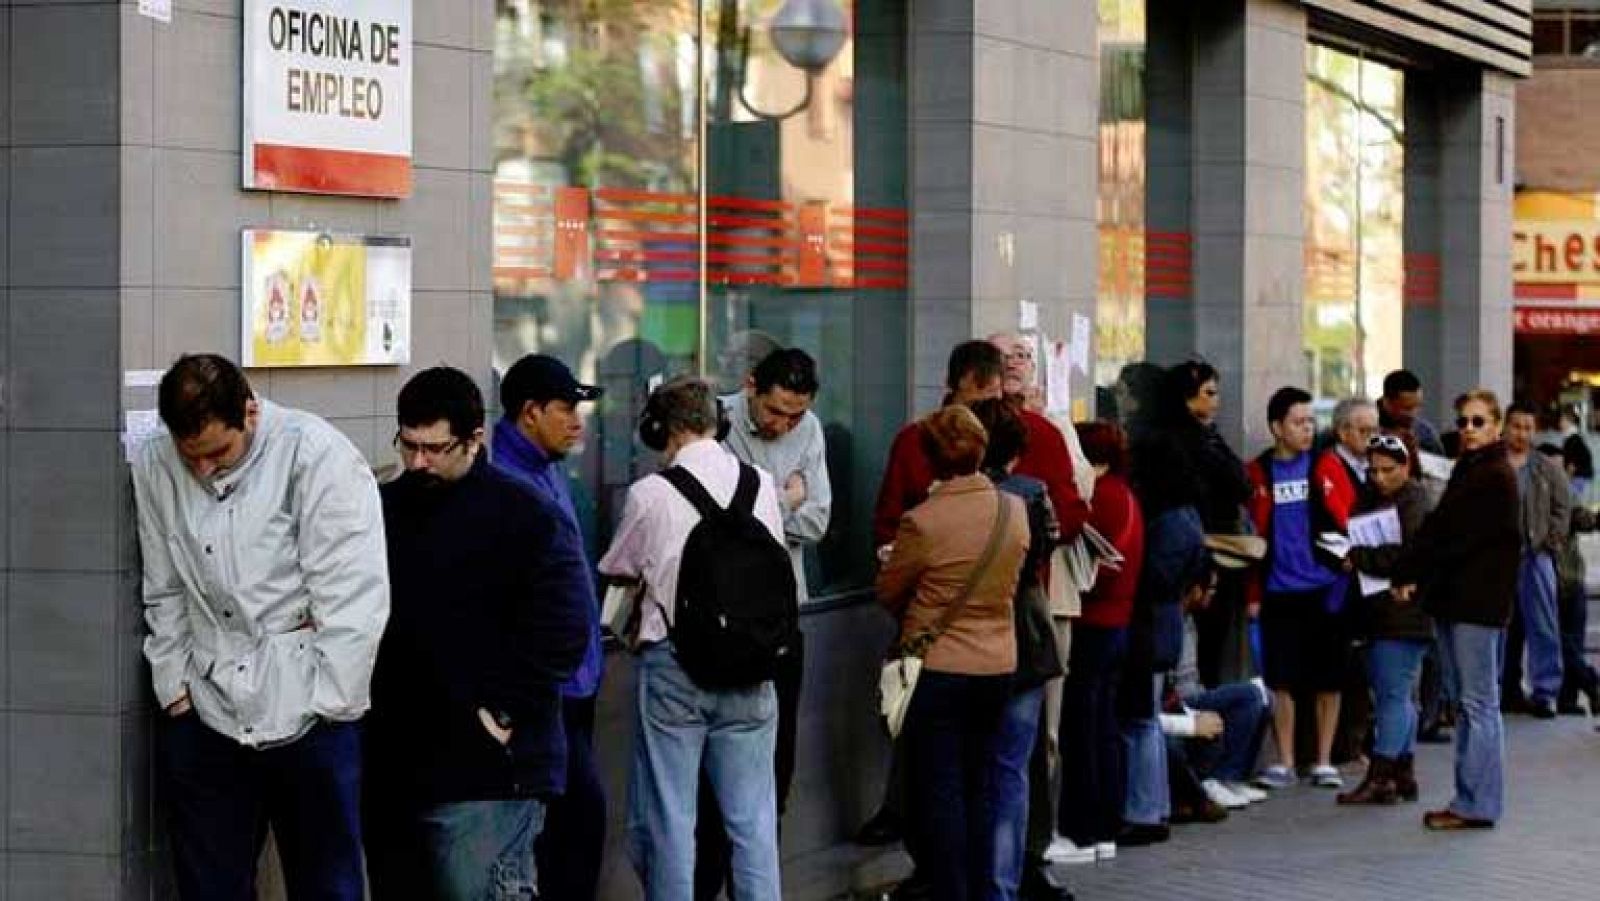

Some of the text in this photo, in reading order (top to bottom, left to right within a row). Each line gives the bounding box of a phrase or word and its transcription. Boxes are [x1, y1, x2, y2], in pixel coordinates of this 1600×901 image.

[268, 5, 400, 66] OFICINA DE
[287, 68, 384, 122] EMPLEO
